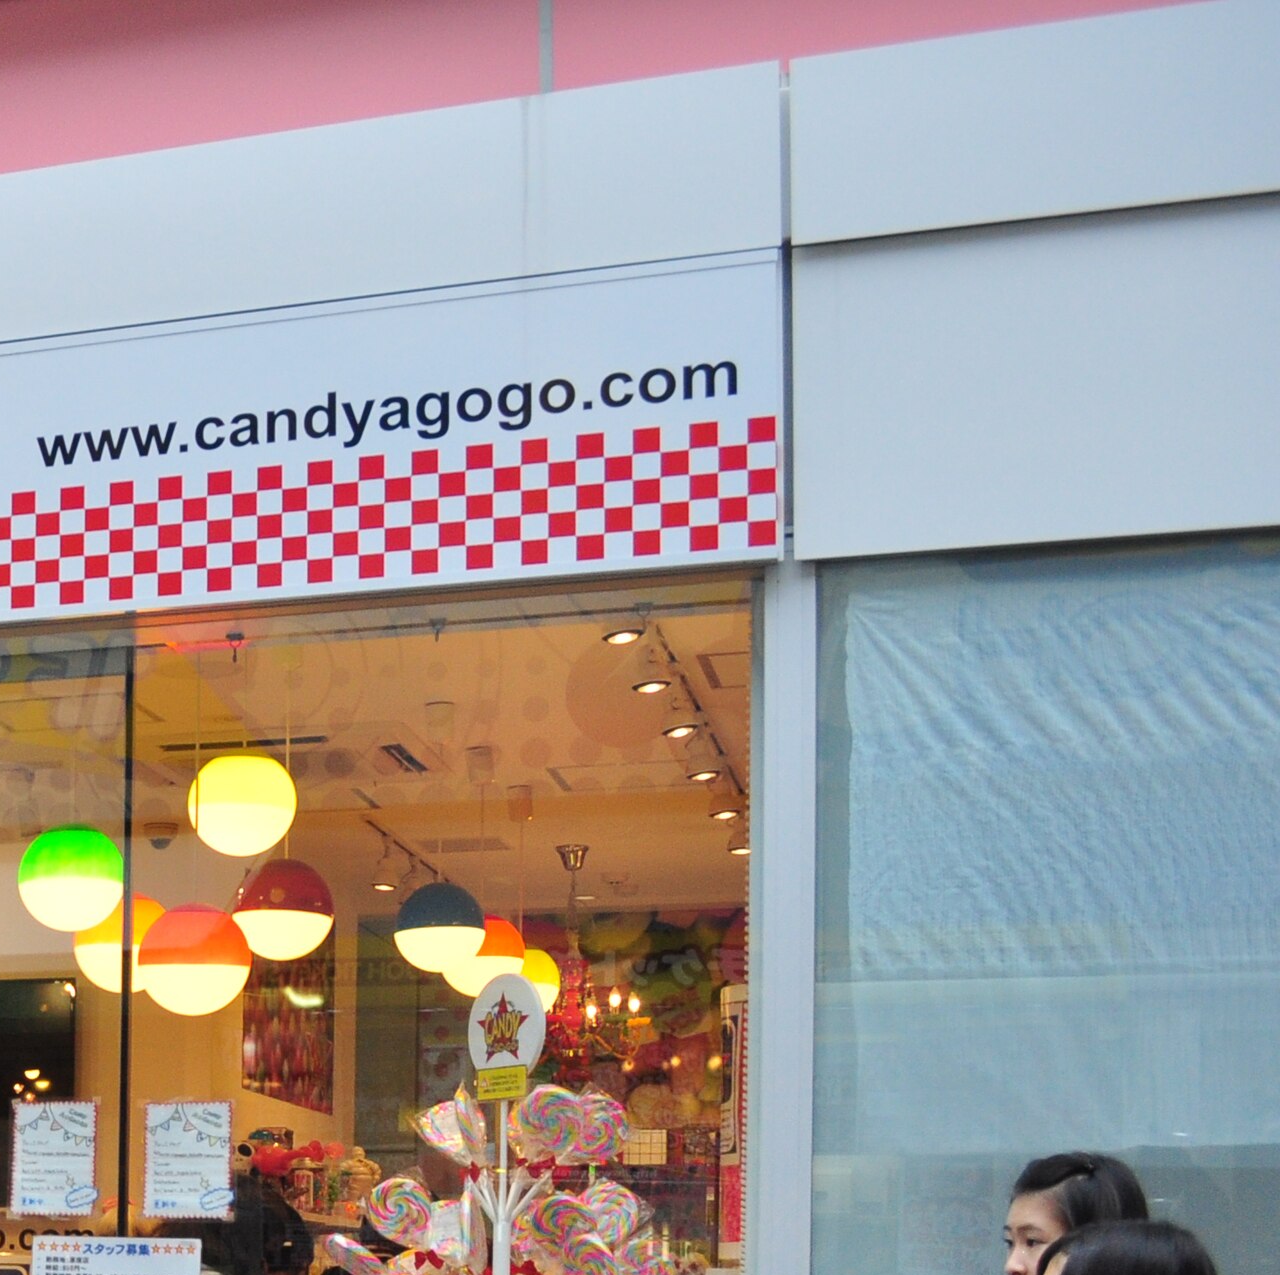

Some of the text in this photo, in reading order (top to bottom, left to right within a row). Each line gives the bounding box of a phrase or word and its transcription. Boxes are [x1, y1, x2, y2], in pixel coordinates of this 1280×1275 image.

[36, 360, 740, 468] www.candyagogo.com
[82, 1243, 151, 1256] スタッフ募集
